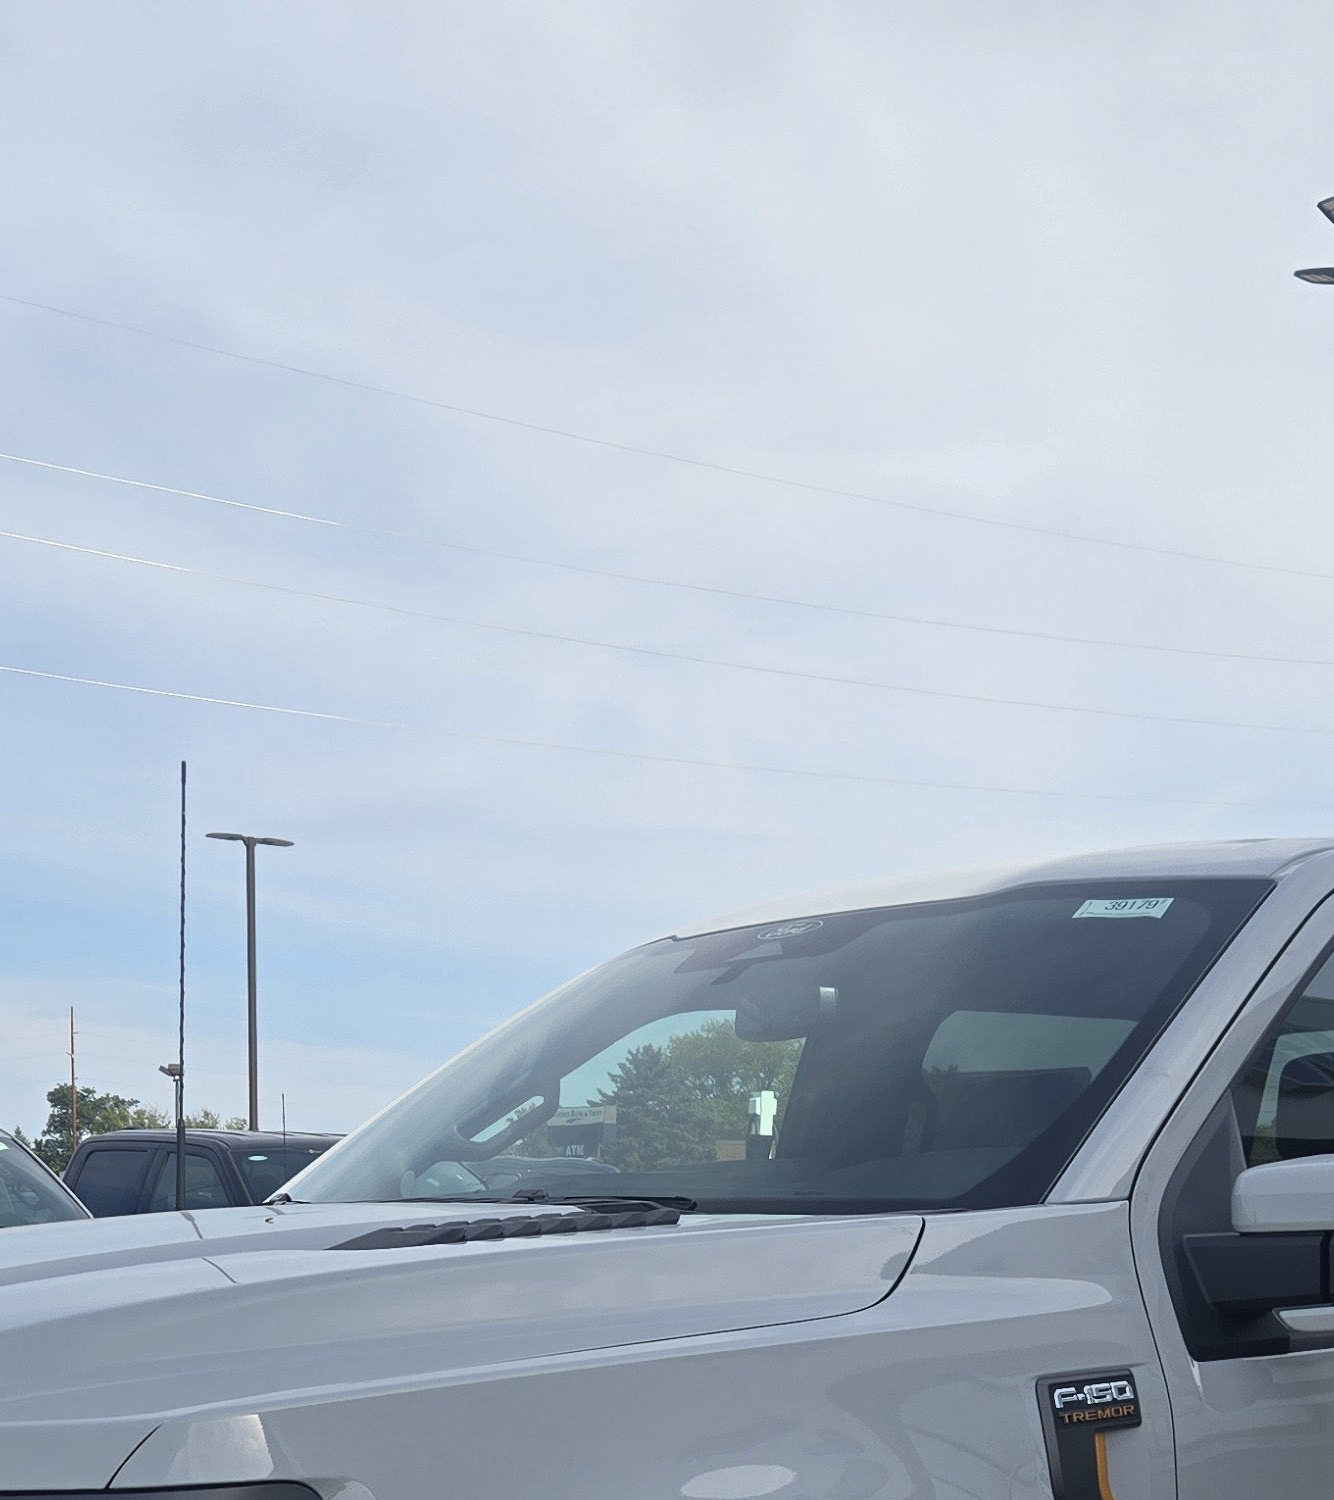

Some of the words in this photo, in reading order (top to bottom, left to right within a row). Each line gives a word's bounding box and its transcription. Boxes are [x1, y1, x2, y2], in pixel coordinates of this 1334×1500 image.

[1104, 900, 1160, 910] 39179
[565, 1144, 584, 1156] ATM
[1053, 1380, 1134, 1409] F-150
[1059, 1404, 1135, 1424] TREMOR
